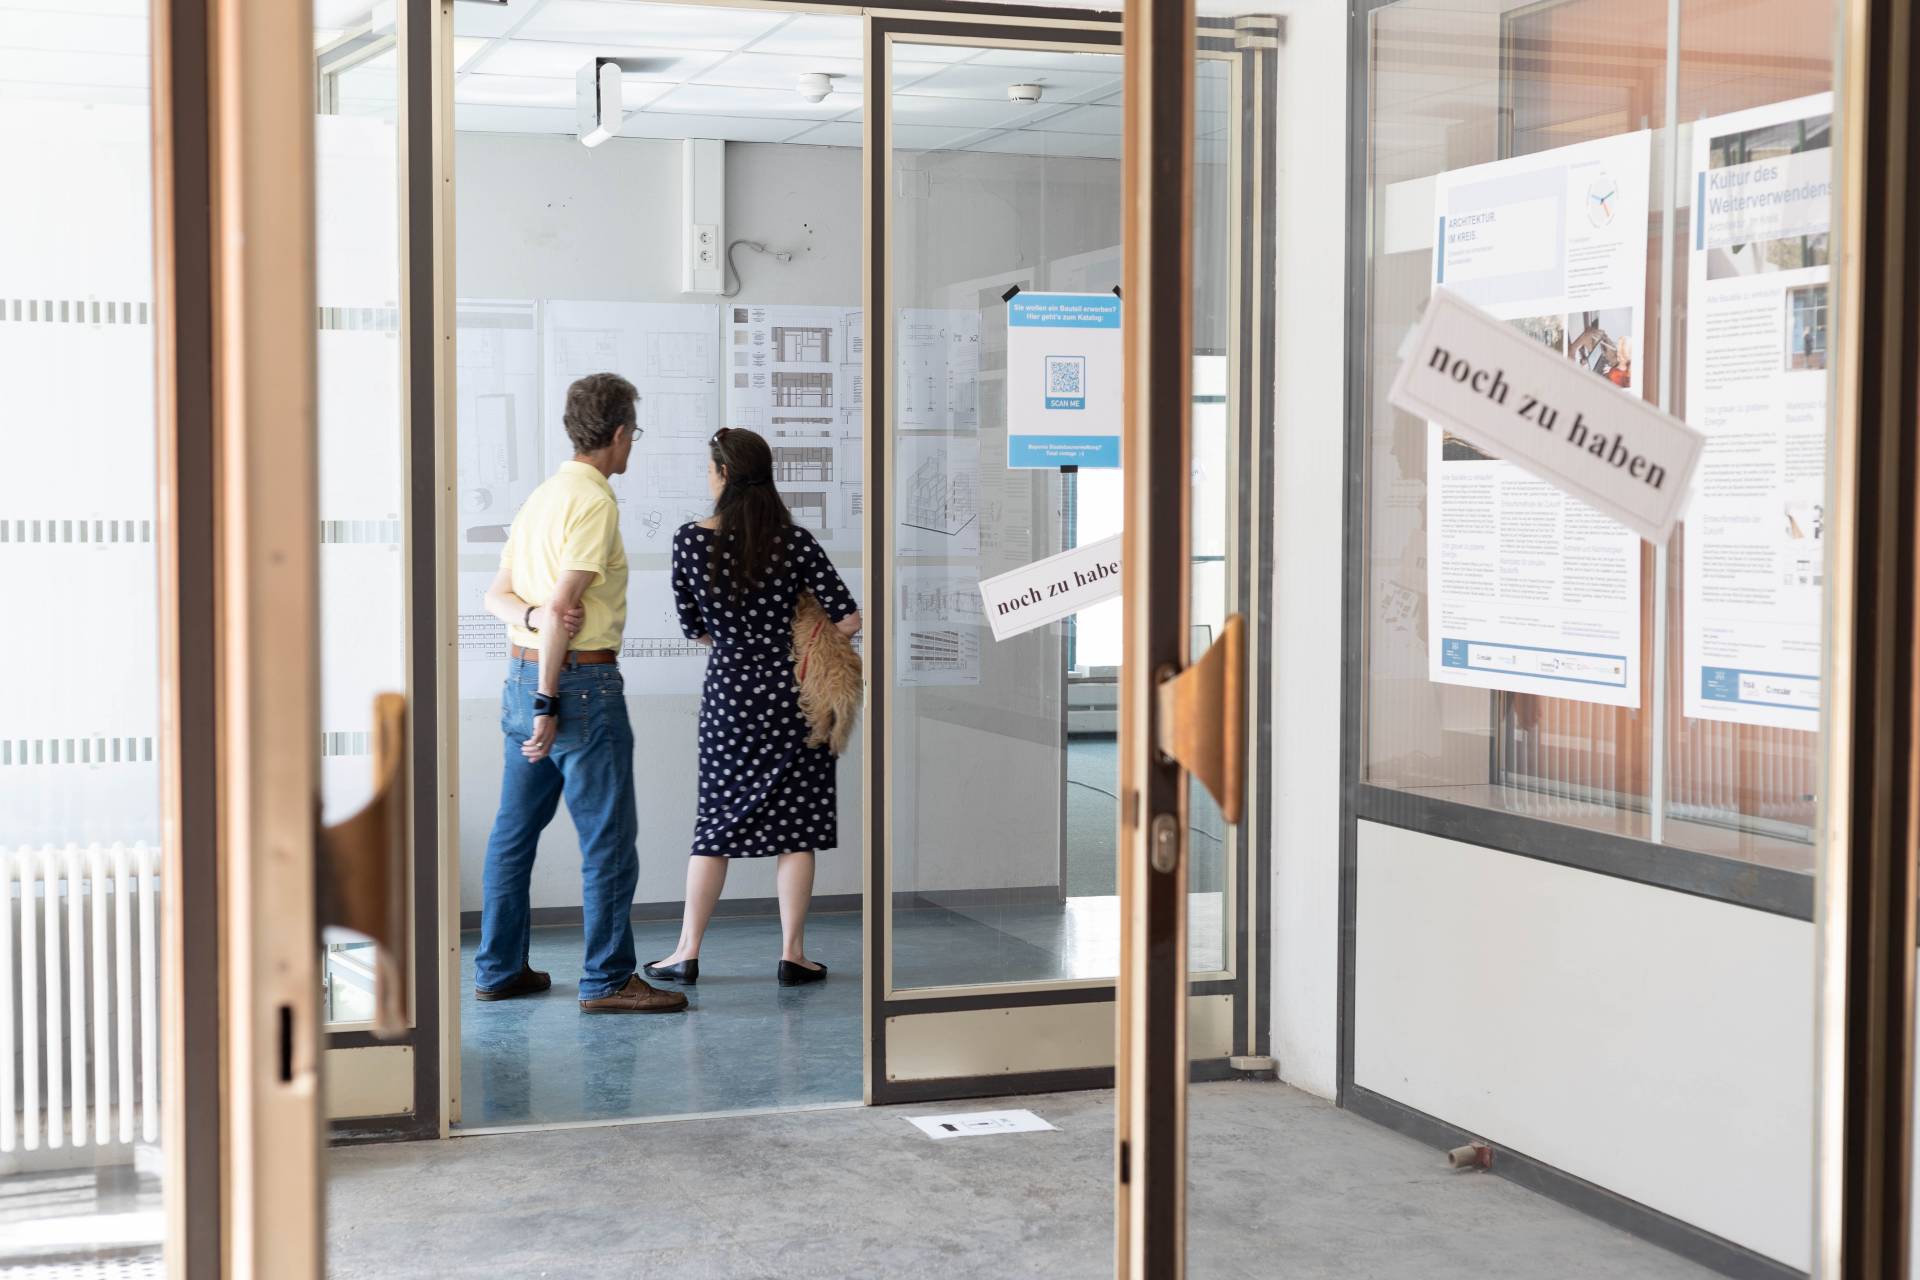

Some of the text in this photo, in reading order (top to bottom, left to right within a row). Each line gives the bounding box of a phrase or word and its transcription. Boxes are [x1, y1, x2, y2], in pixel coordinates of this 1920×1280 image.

[1710, 165, 1778, 191] Kultur des
[1013, 304, 1025, 312] Sie
[1025, 304, 1047, 312] wollen
[1041, 313, 1061, 321] geht's
[1077, 314, 1104, 322] Katalog:
[1050, 399, 1081, 408] SCAN ME
[1428, 345, 1511, 406] noch
[1518, 393, 1559, 432] zu
[1566, 413, 1667, 491] haben
[997, 559, 1122, 615] noch zu habe
